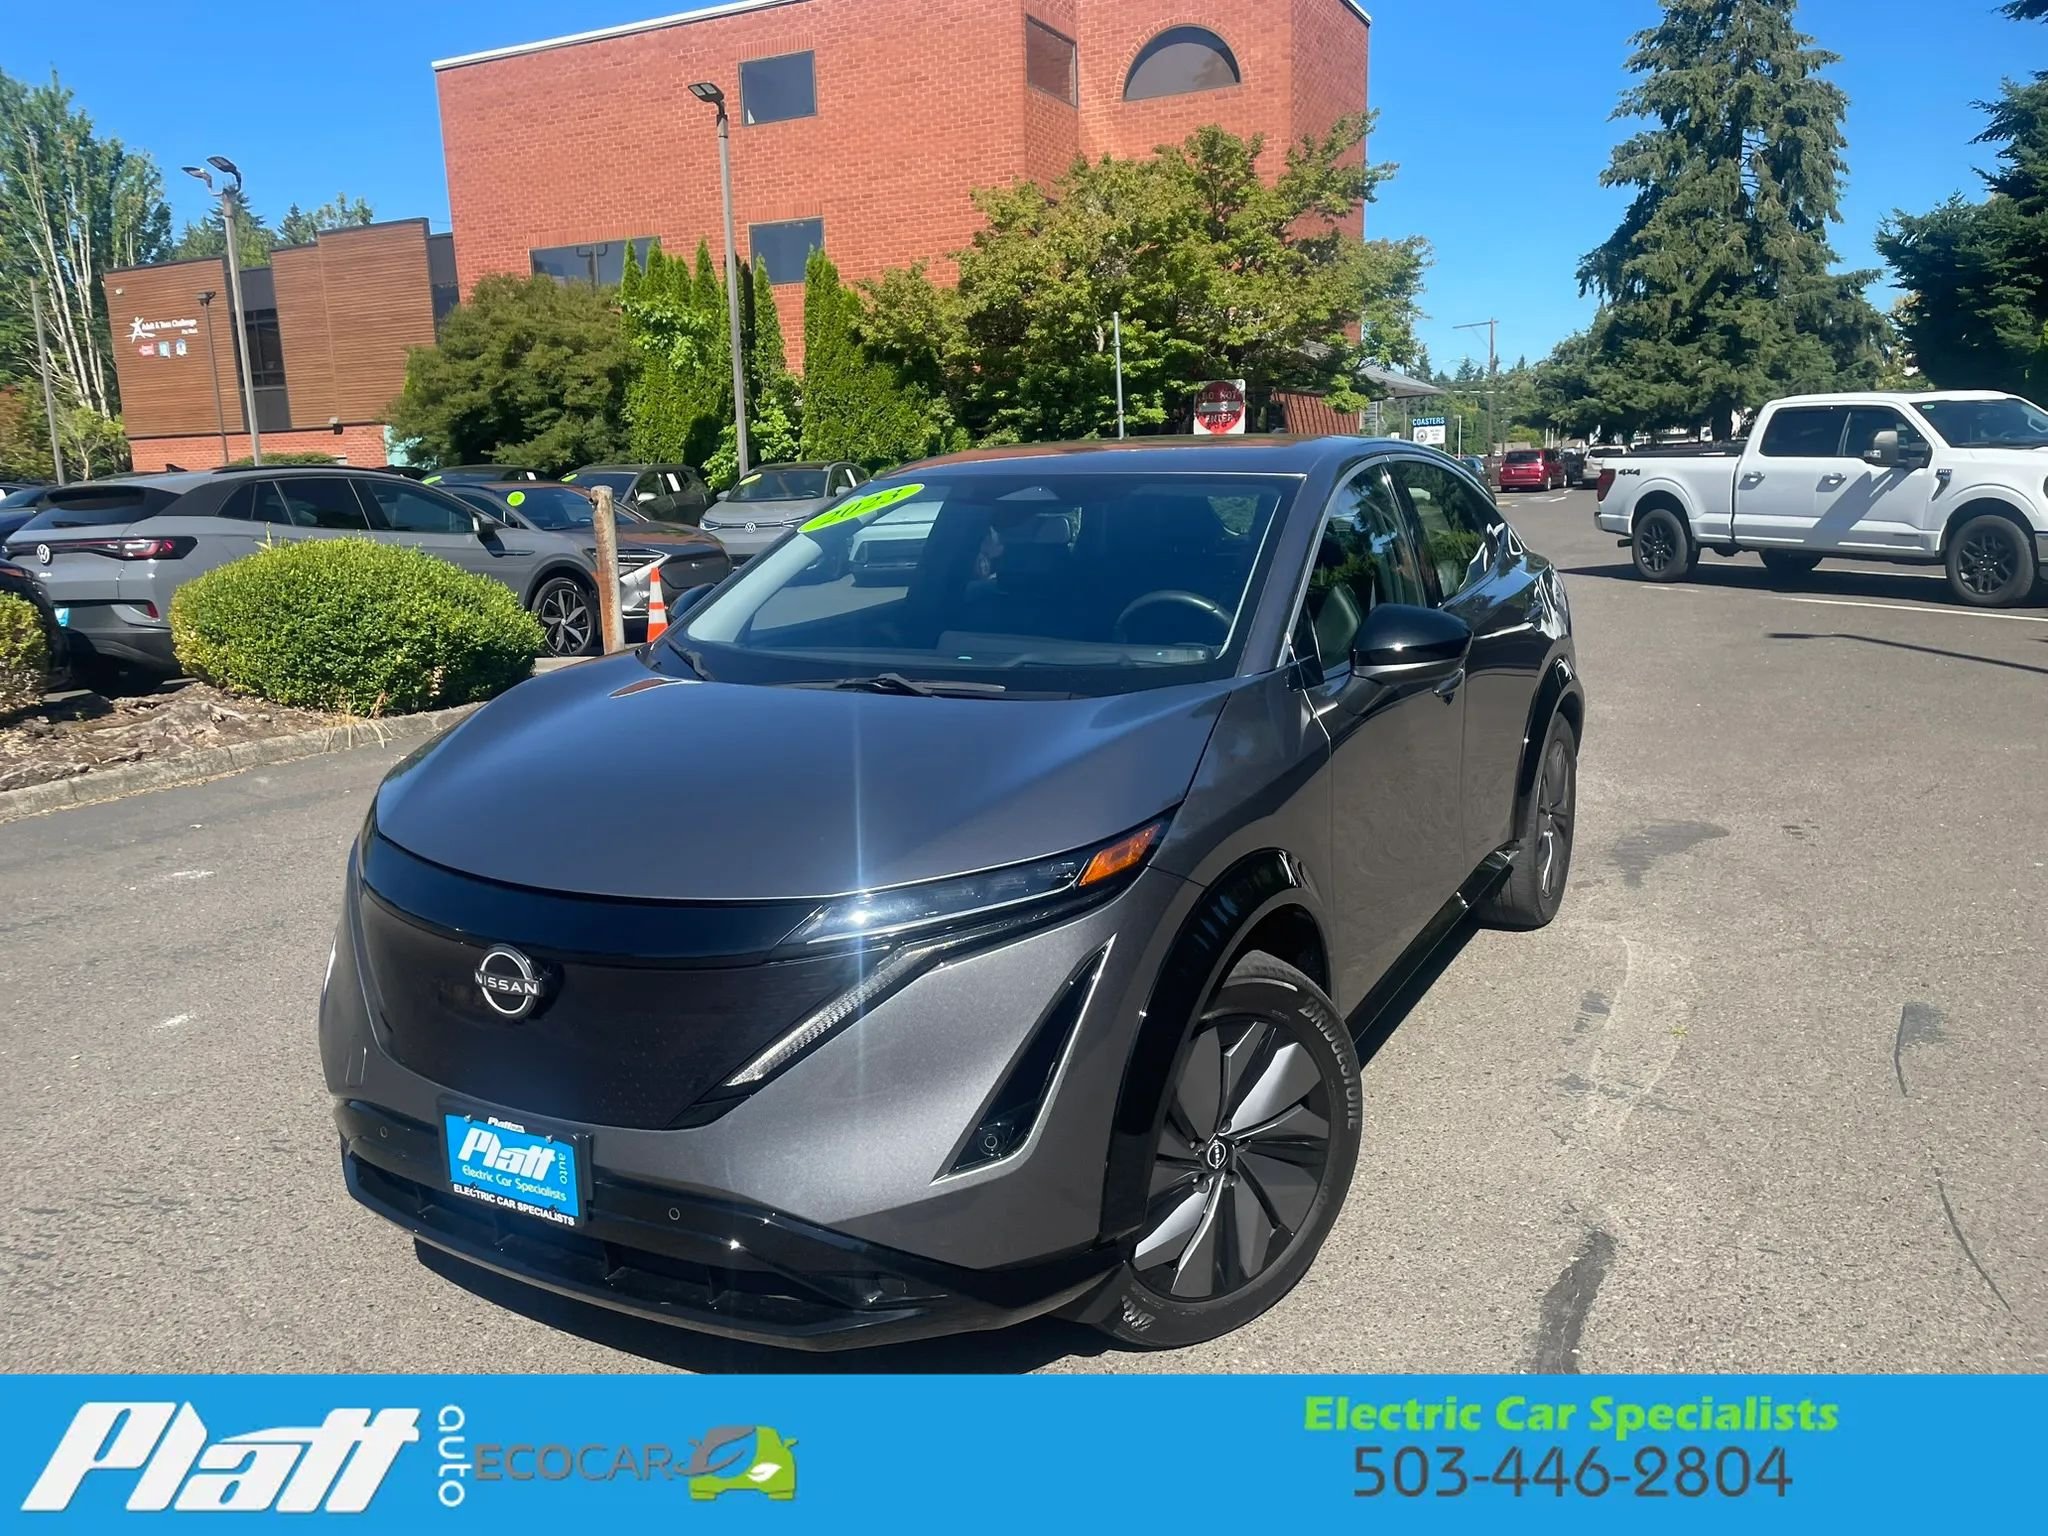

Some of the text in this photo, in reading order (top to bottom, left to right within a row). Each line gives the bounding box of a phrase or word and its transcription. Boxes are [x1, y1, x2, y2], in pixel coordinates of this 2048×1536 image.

[1202, 389, 1237, 400] DO NOT
[1206, 413, 1233, 424] ENTER
[1412, 416, 1445, 426] COASTERS
[474, 971, 538, 995] NISSAN
[457, 1127, 556, 1182] Platt
[558, 1151, 569, 1185] auto
[462, 1164, 567, 1202] Electric Car Specialists
[453, 1184, 575, 1226] ELECTRIC CAR SPECIALISTS
